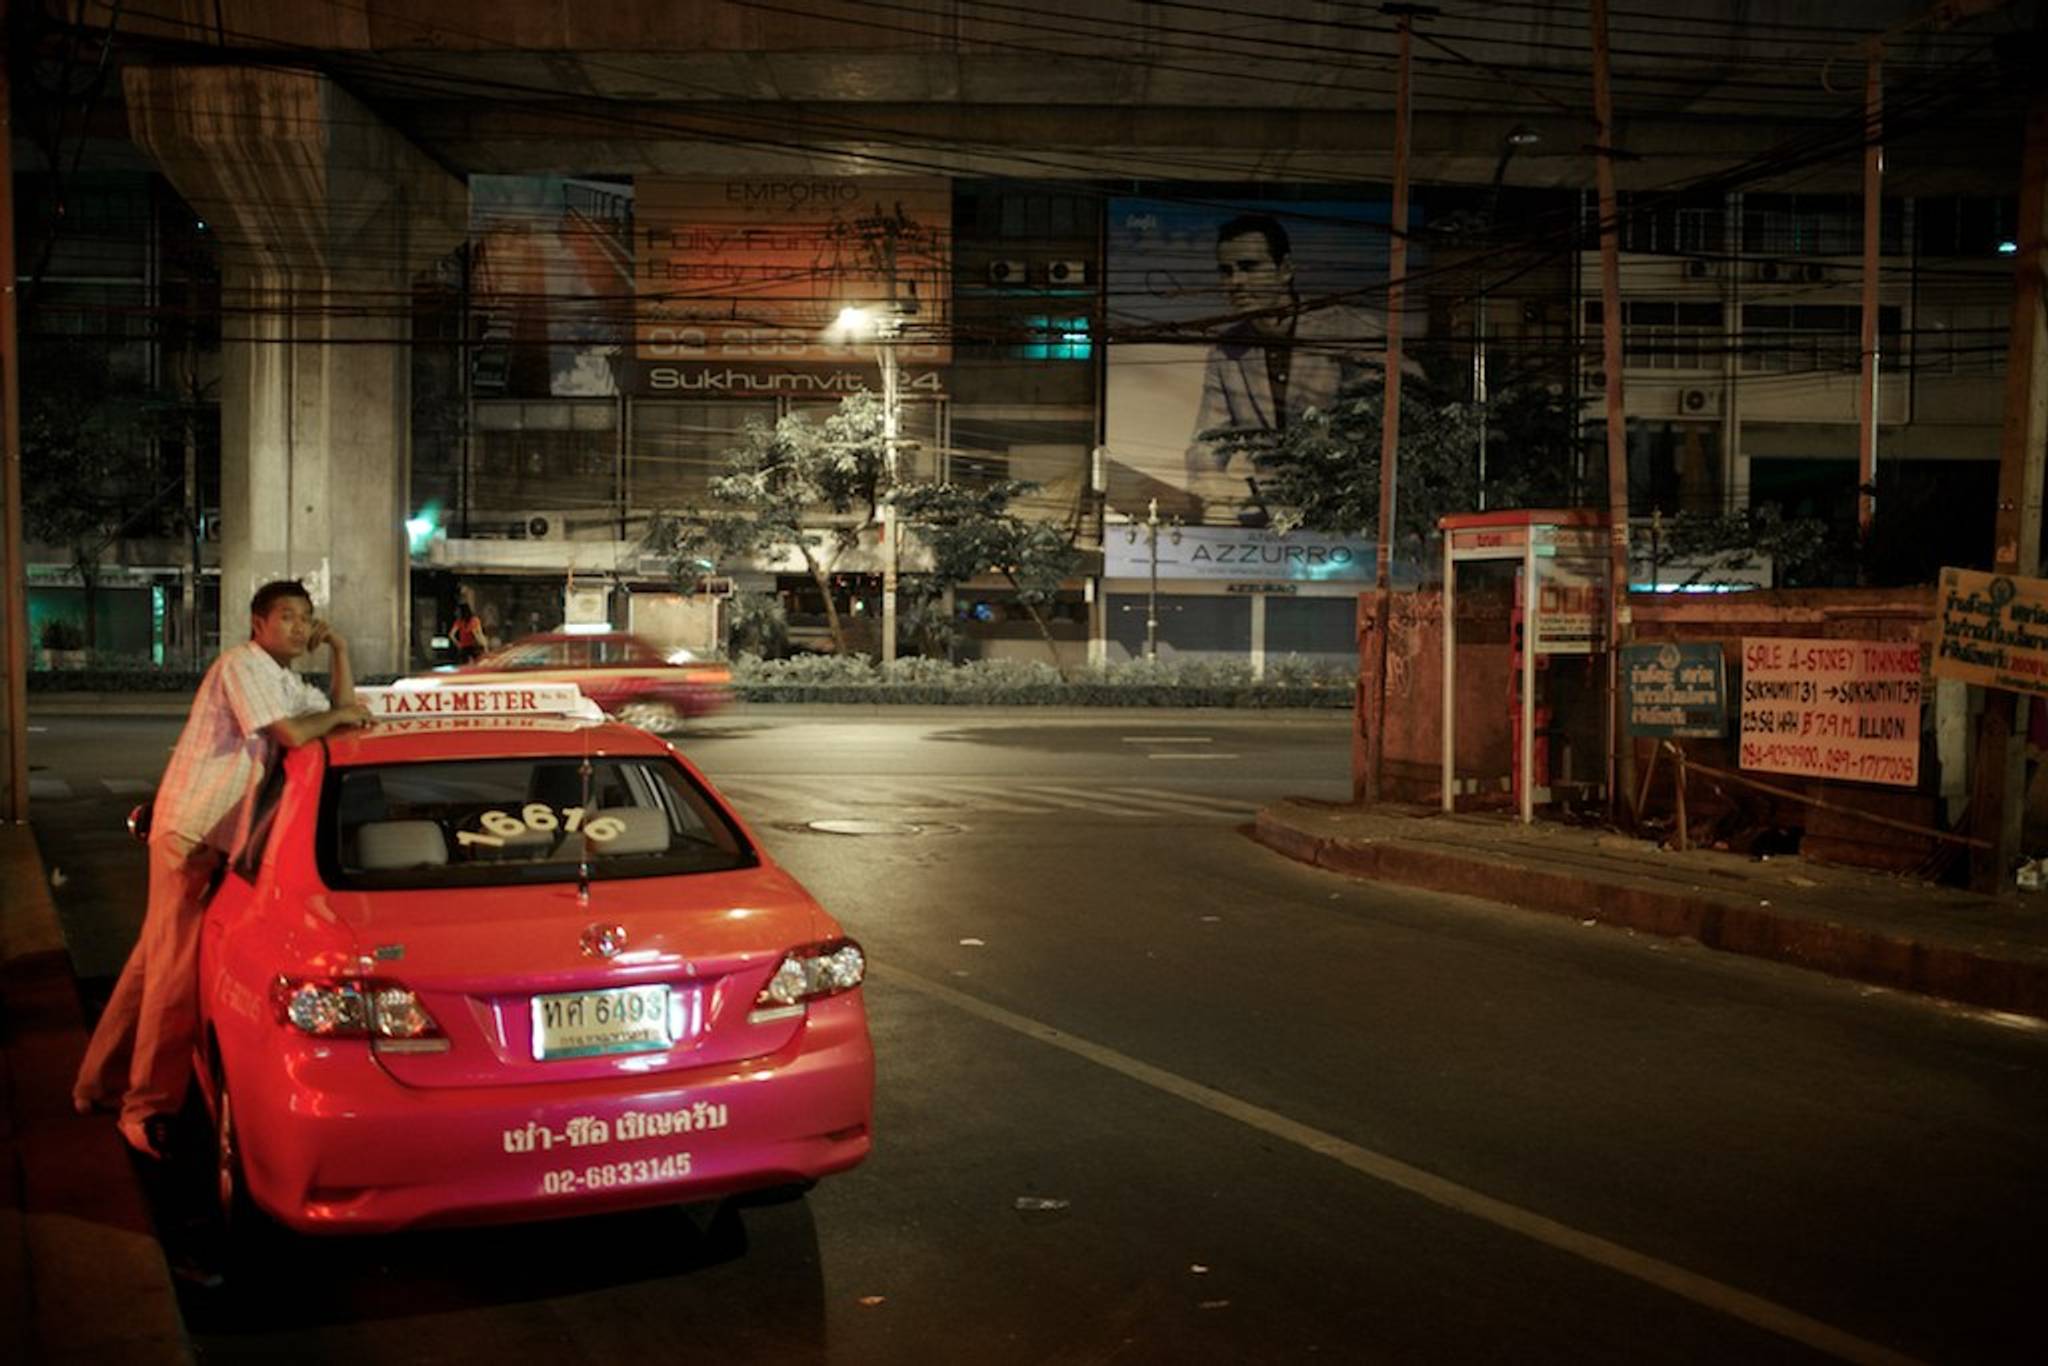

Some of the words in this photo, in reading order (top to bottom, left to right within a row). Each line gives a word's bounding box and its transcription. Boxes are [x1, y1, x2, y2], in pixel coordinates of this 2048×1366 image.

[725, 181, 859, 202] EMPORIO
[649, 327, 706, 355] 02
[649, 367, 863, 391] Sukhumvit
[1191, 544, 1353, 564] AZZURRO
[1746, 644, 1782, 672] SALE
[381, 691, 539, 713] TAXI-METER
[455, 802, 627, 847] 16616
[595, 992, 662, 1025] 6493
[615, 1100, 729, 1142] เชิญครับ
[543, 1152, 692, 1195] 02-6833145
